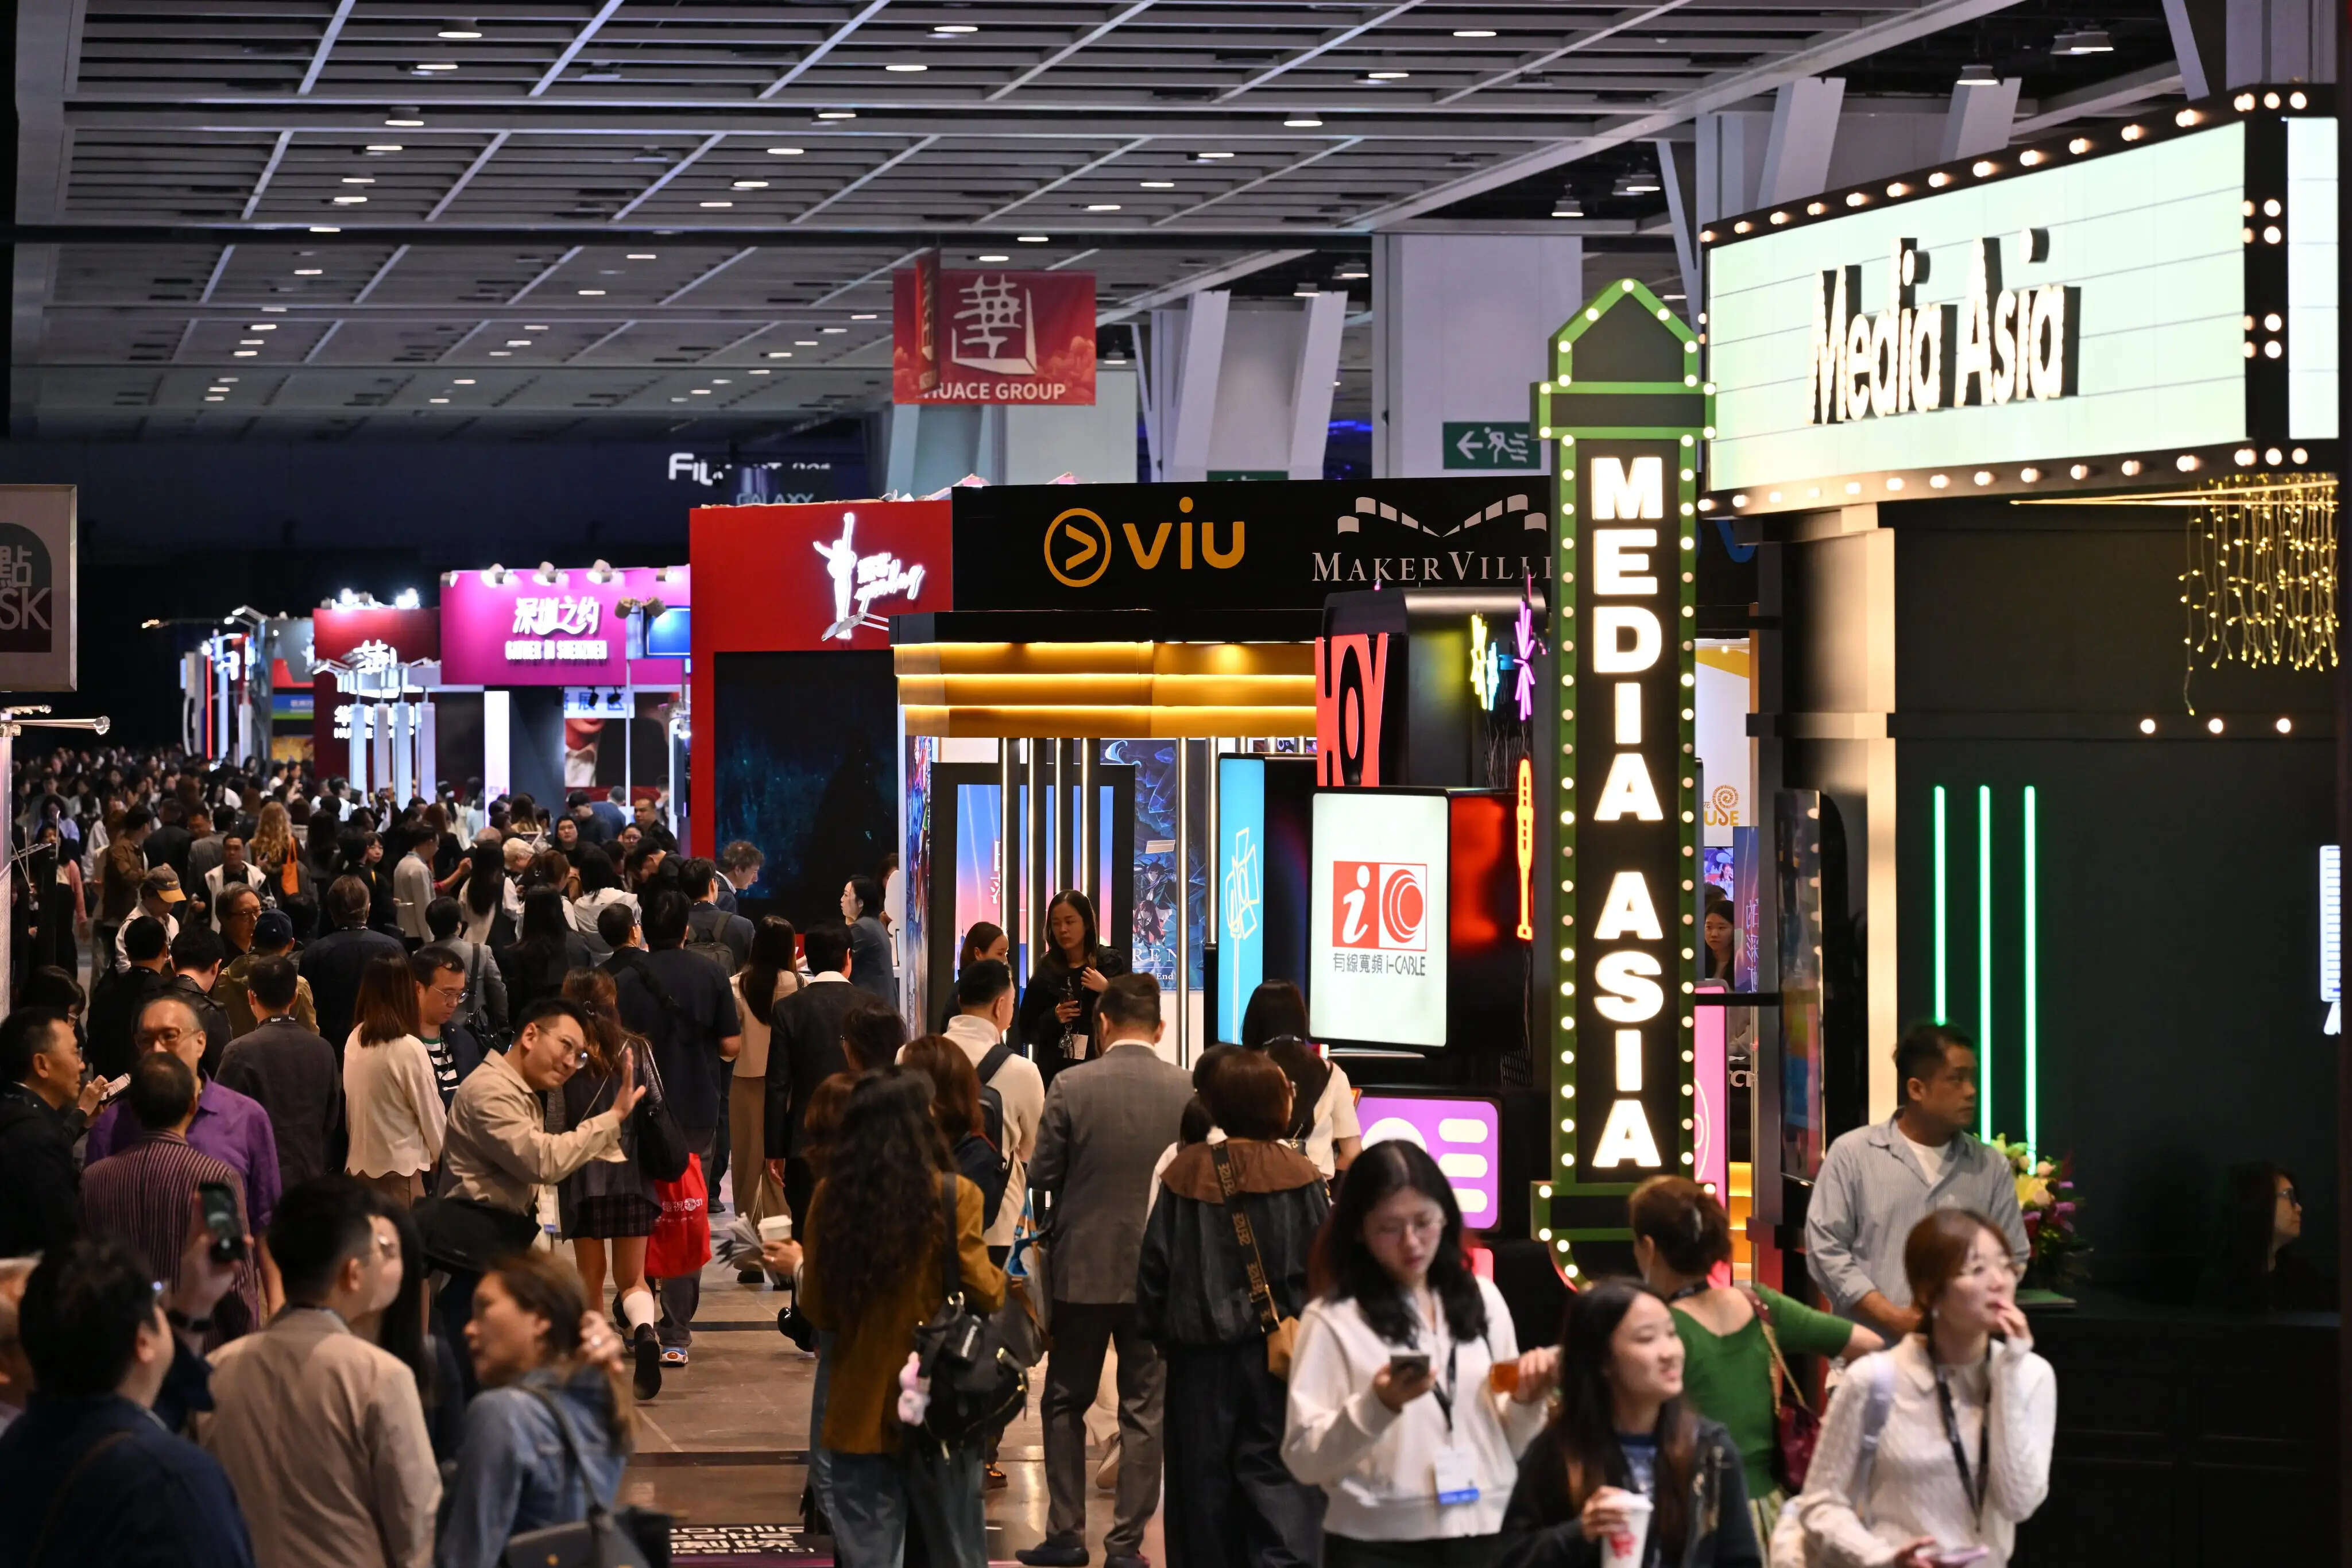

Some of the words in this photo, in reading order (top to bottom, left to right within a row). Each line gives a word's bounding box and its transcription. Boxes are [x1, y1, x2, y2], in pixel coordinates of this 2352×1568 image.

[996, 382, 1066, 400] GROUP
[1806, 238, 1958, 425] Media
[1954, 228, 2081, 407] Asia
[1122, 496, 1245, 570] viu
[1315, 632, 1388, 787] HOY
[1591, 457, 1663, 821] MEDIA
[1591, 871, 1664, 1168] ASIA
